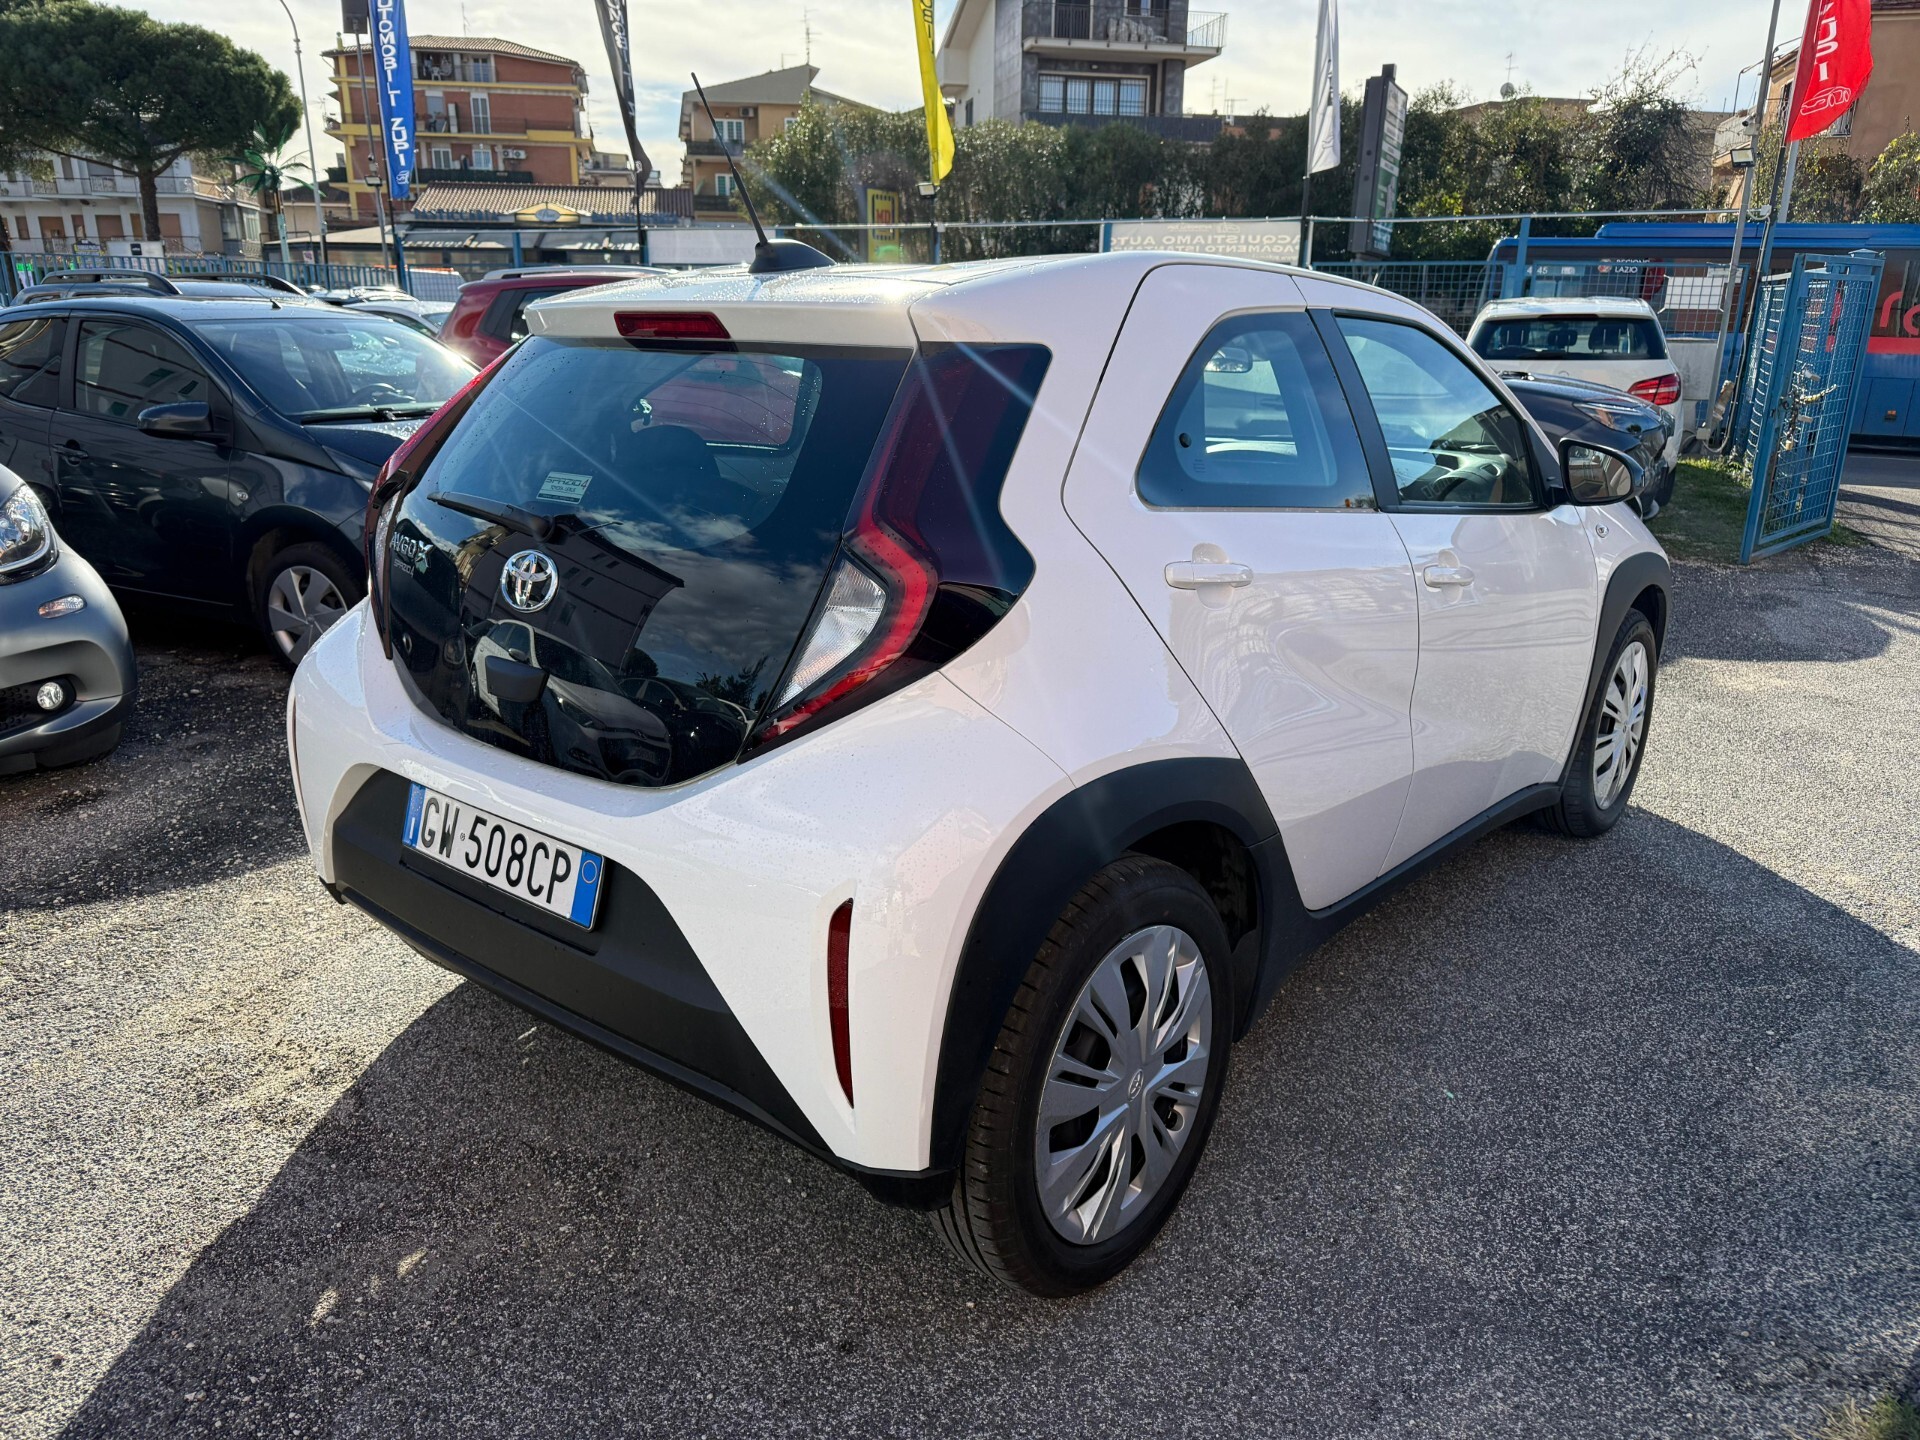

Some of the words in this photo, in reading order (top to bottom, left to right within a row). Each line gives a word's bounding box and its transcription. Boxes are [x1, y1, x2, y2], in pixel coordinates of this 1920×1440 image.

[391, 117, 410, 166] ZUPI
[1614, 265, 1638, 273] LAZIO
[464, 814, 572, 905] 508CP
